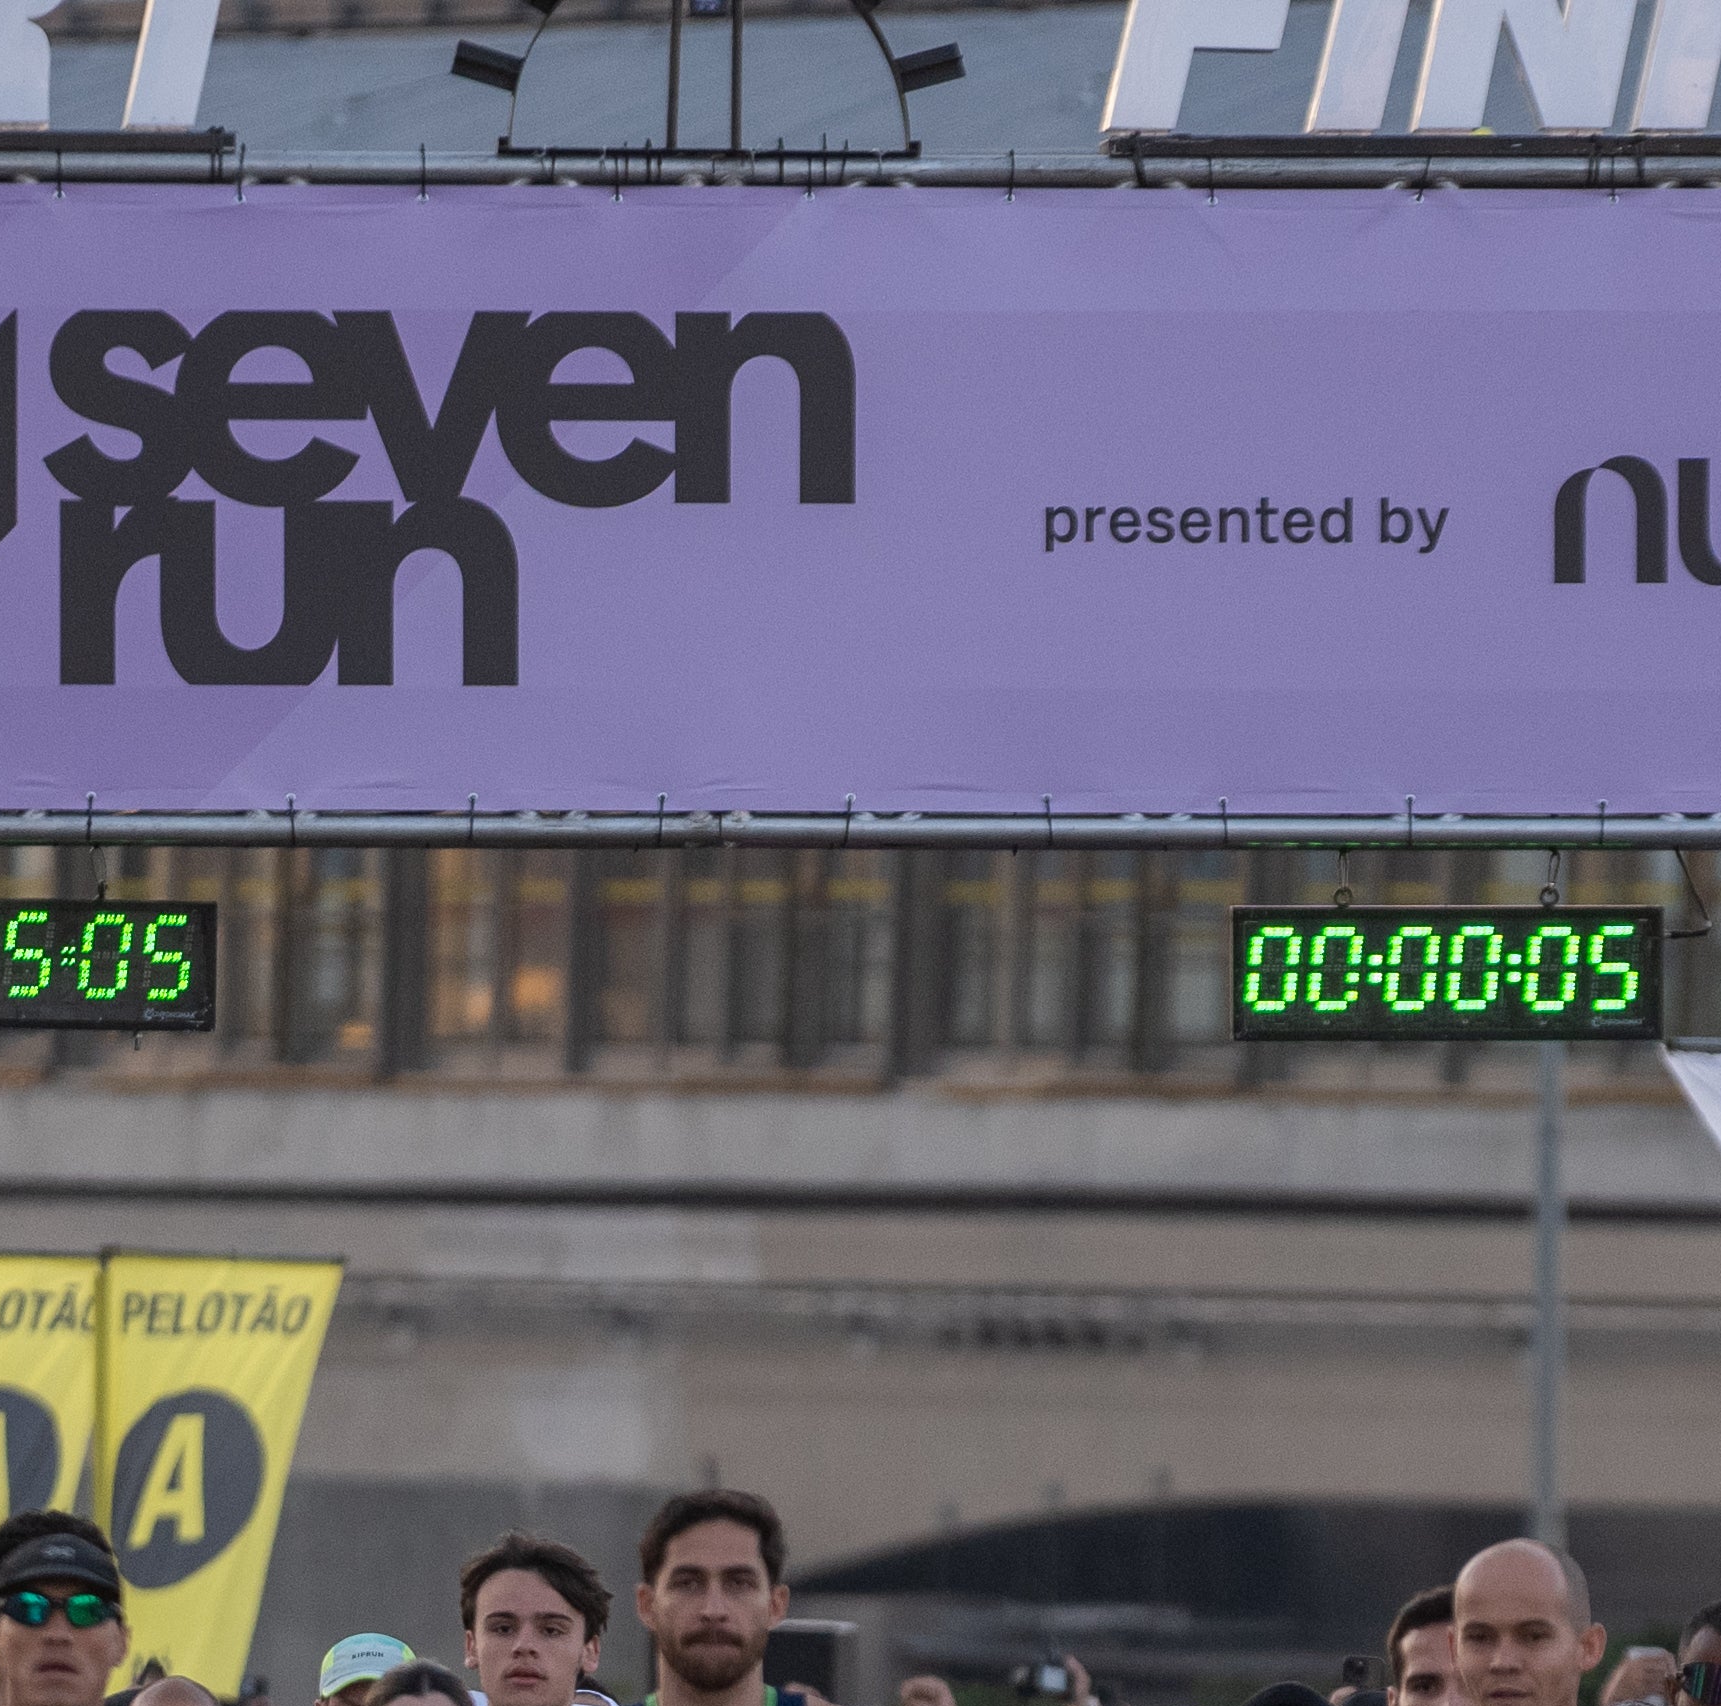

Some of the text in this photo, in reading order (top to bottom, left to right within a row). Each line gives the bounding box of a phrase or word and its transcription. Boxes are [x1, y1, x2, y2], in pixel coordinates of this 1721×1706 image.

[42, 308, 857, 508] seven
[1043, 496, 1452, 554] presented by
[58, 494, 519, 686] run
[1243, 924, 1640, 1012] 00:00:05
[121, 1286, 312, 1337] PELOTÃO
[126, 1411, 206, 1551] A
[351, 1651, 384, 1659] KIPRUN
